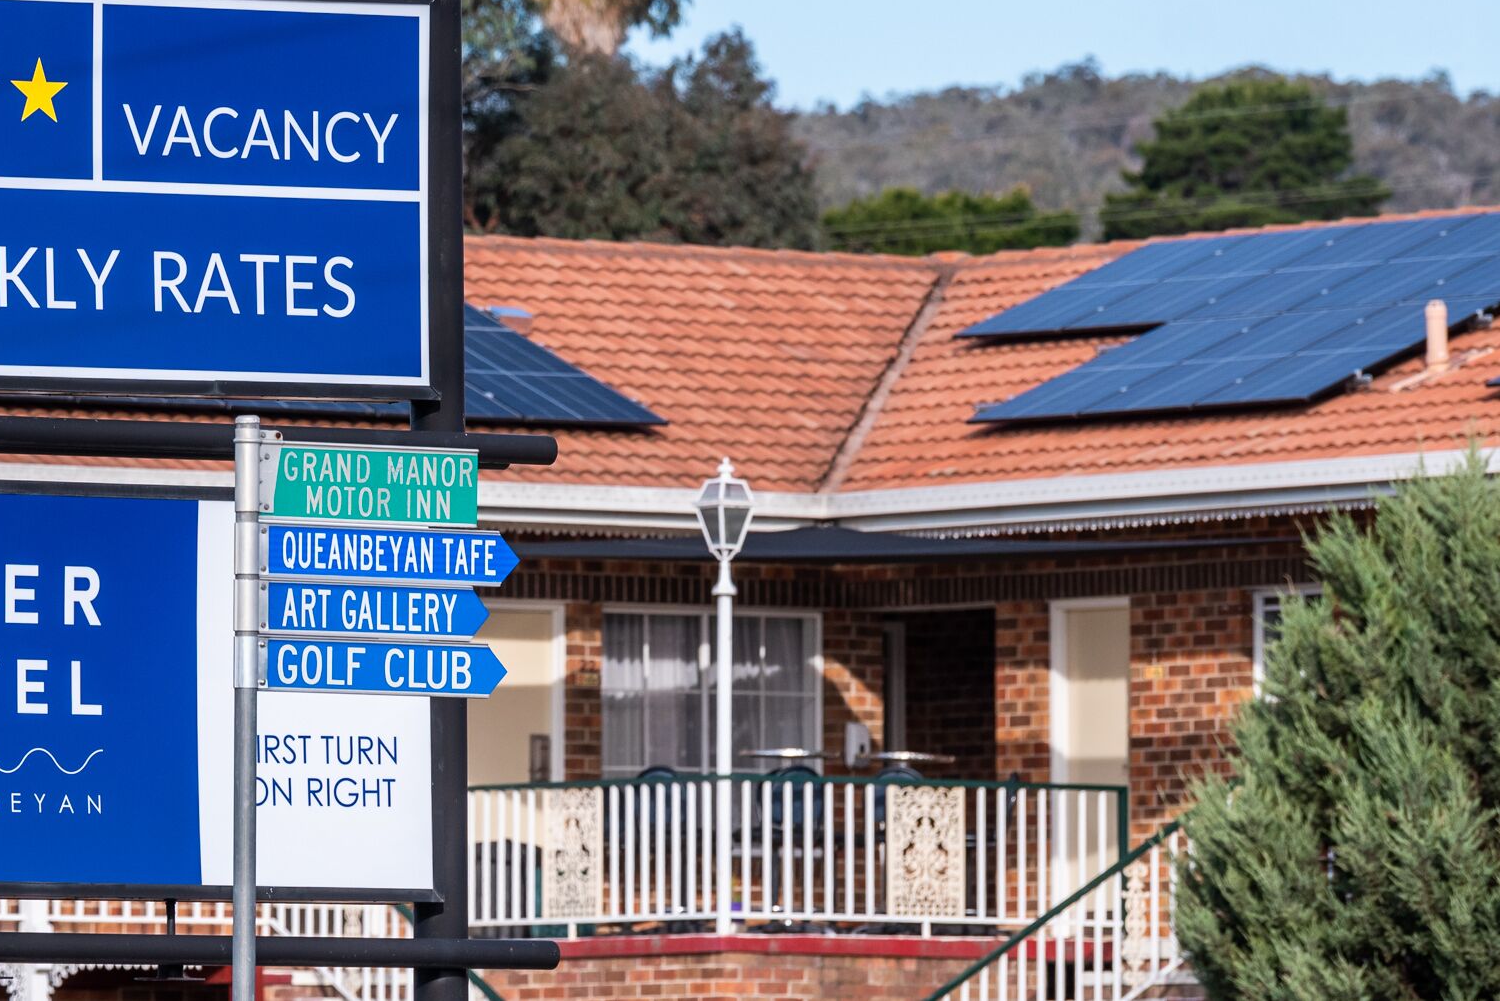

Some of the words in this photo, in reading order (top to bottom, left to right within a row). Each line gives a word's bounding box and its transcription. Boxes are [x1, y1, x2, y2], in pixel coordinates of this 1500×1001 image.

[122, 103, 399, 164] VACANCY
[153, 250, 356, 318] RATES
[284, 451, 371, 484] GRAND
[387, 455, 474, 487] MANOR
[306, 485, 391, 518] MOTOR
[406, 489, 451, 520] INN
[282, 530, 435, 574] QUEANBEYAN
[442, 538, 497, 576] TAFE
[281, 587, 332, 629] ART
[340, 590, 458, 633] GALLERY
[277, 644, 366, 687] GOLF
[384, 648, 472, 691] CLUB
[256, 734, 312, 765] IRST
[320, 735, 398, 766] TURN
[307, 777, 396, 808] RIGHT
